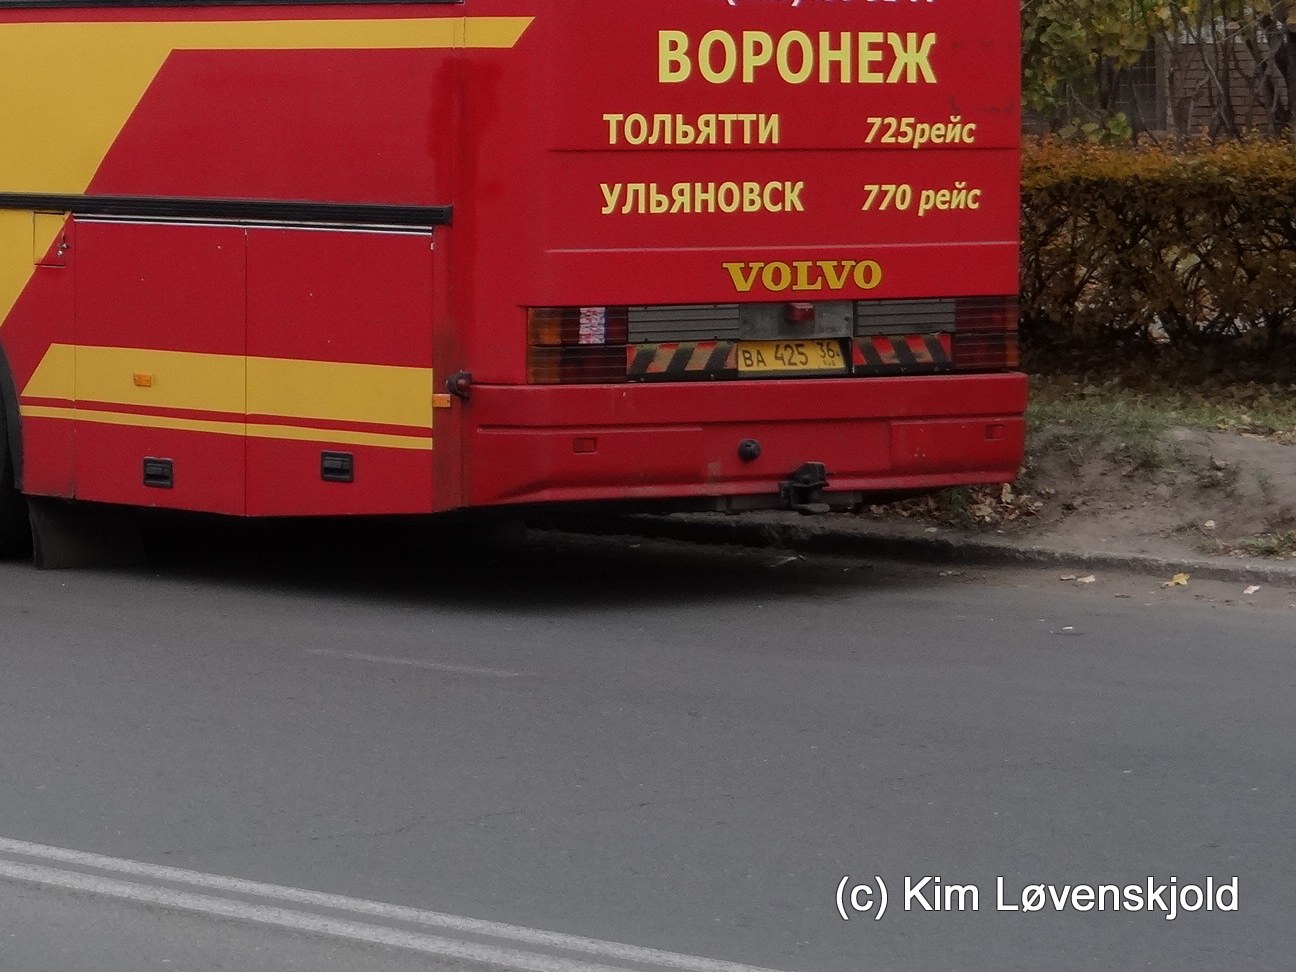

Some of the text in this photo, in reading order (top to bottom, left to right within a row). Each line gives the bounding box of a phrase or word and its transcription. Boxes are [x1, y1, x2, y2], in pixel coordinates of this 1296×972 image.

[657, 30, 937, 84] ВОРОНЕЖ
[602, 113, 977, 148] ТОЛЬЯТТИ 725рейс
[600, 181, 981, 216] УЛЬЯНОВСК 770 рейс
[723, 260, 883, 292] VOLVO
[774, 343, 809, 366] 425
